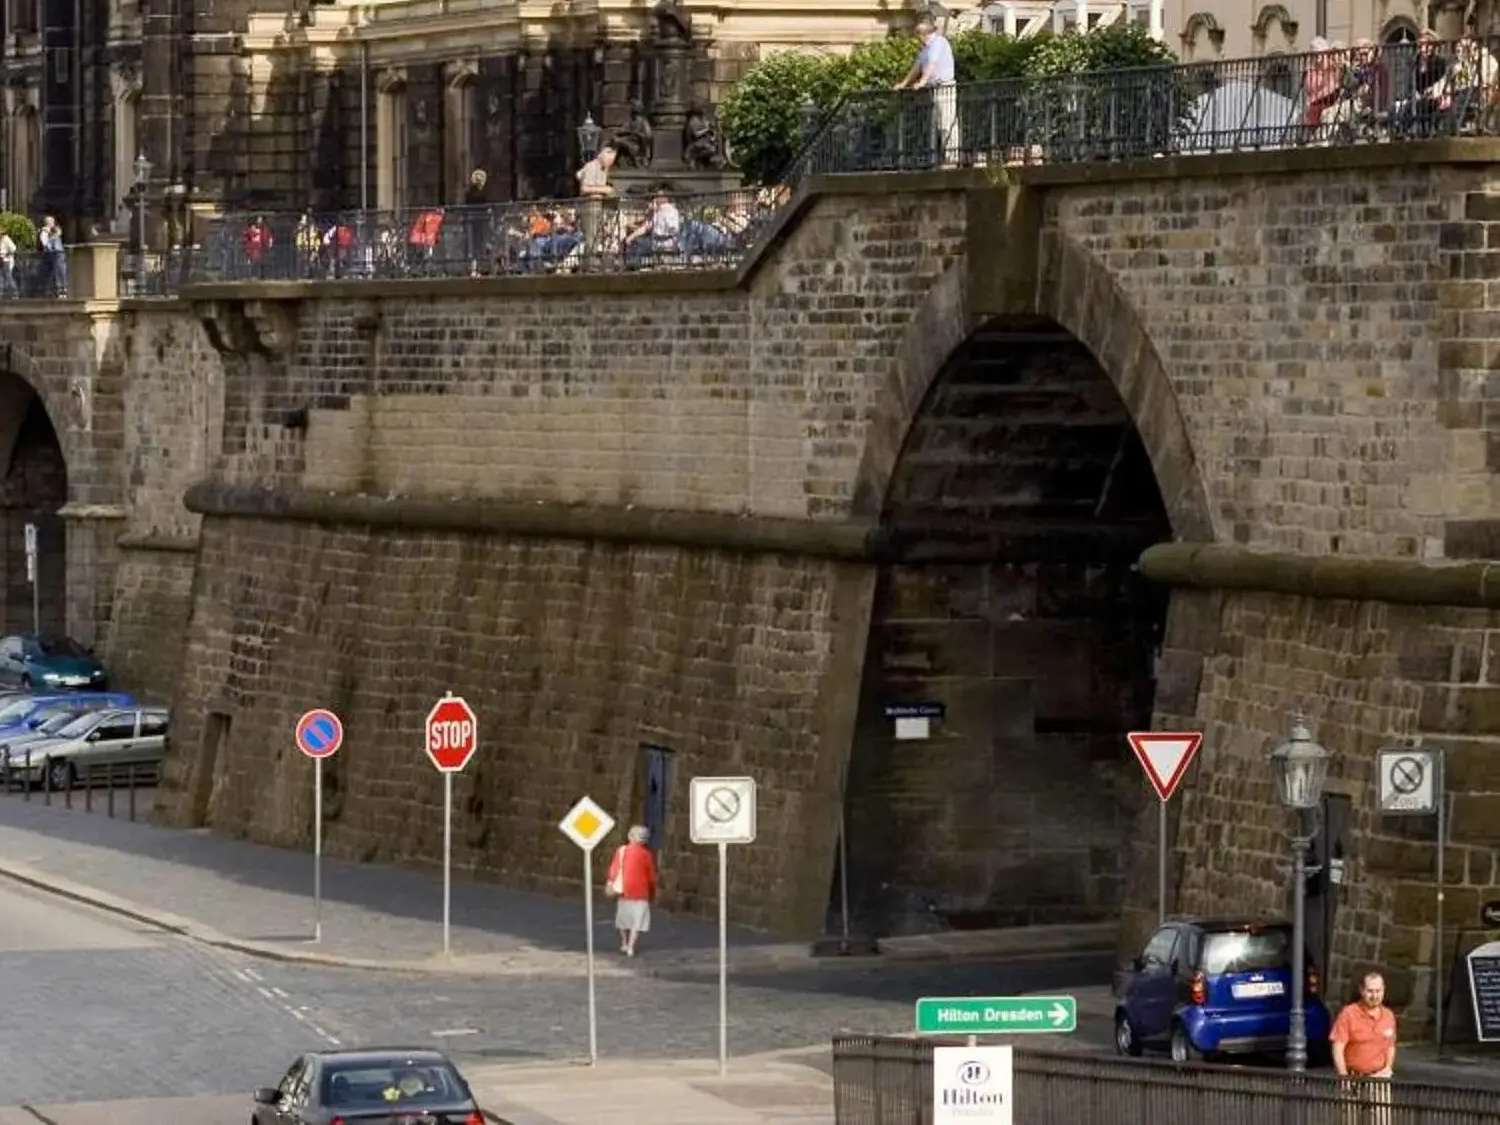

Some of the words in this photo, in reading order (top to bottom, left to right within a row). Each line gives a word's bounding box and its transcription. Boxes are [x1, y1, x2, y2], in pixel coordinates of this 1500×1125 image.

[431, 720, 471, 750] STOP
[937, 1008, 979, 1023] Hilton
[984, 1007, 1044, 1022] Dresden
[943, 1088, 1004, 1106] Hilton
